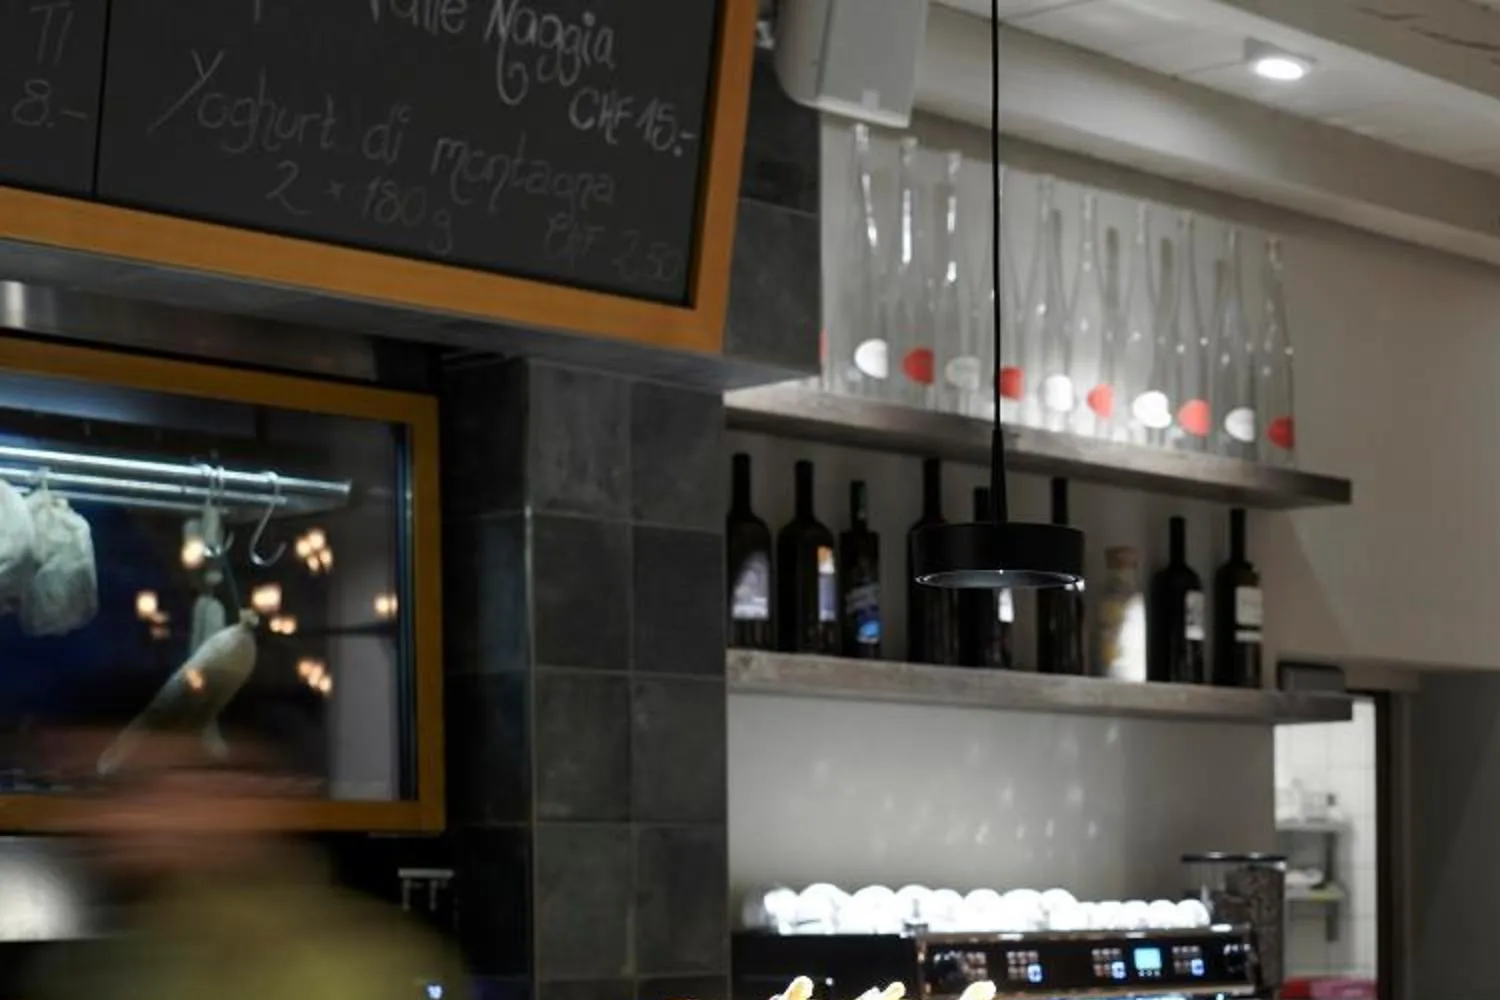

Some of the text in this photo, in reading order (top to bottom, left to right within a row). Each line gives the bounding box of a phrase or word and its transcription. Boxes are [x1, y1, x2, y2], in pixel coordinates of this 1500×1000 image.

[145, 47, 615, 218] Yoghurt di montagna
[568, 86, 634, 145] CHF
[264, 160, 312, 216] 2
